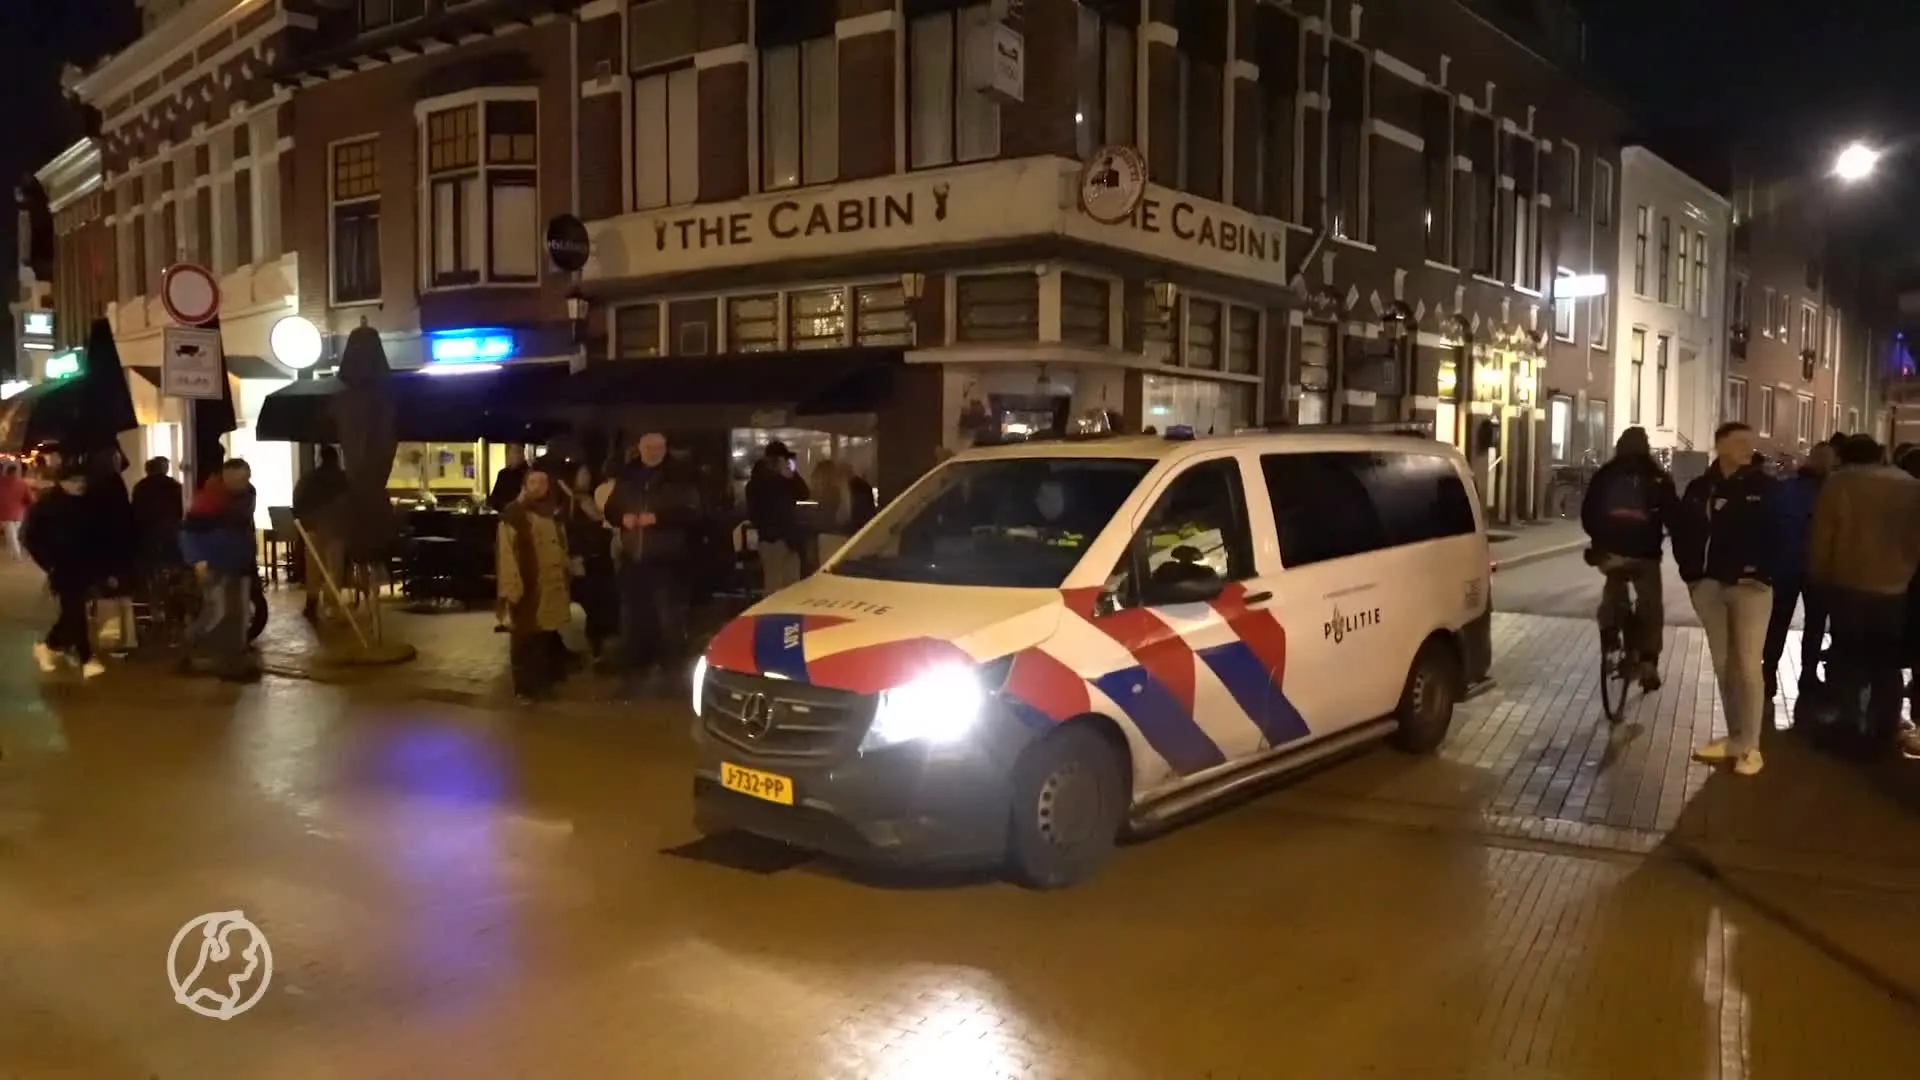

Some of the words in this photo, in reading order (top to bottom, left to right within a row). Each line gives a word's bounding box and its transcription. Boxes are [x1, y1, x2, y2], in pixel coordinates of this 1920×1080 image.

[674, 212, 753, 250] THE
[768, 191, 914, 239] CABIN
[1171, 202, 1266, 261] CABIN
[797, 598, 894, 616] POLITIE
[1324, 607, 1382, 644] POLITIE
[727, 767, 785, 799] J-732-PP
